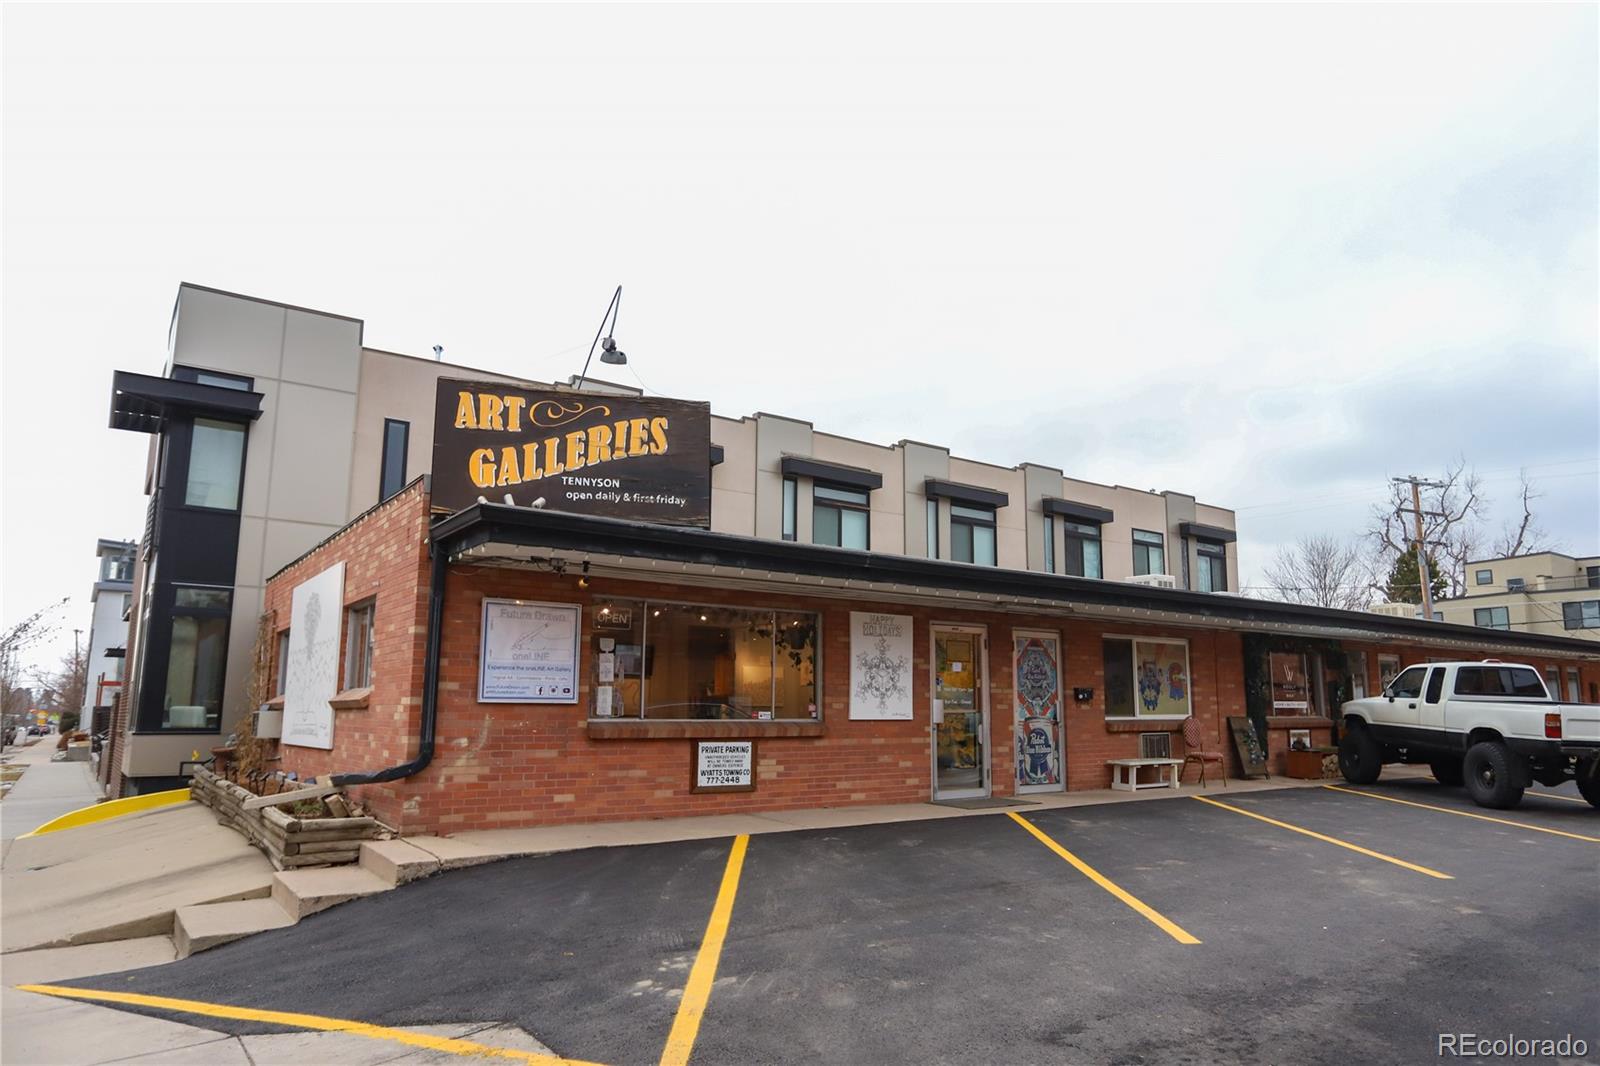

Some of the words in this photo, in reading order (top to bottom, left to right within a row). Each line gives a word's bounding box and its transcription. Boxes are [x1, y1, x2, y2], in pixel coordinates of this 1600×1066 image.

[454, 391, 526, 433] ART
[469, 416, 669, 489] GALLERIES
[561, 476, 620, 489] TENNYSON
[566, 491, 593, 501] open
[595, 491, 621, 504] daily
[623, 493, 631, 502] &
[656, 495, 686, 507] friday
[597, 611, 628, 624] OPEN
[870, 614, 895, 624] HAPPY
